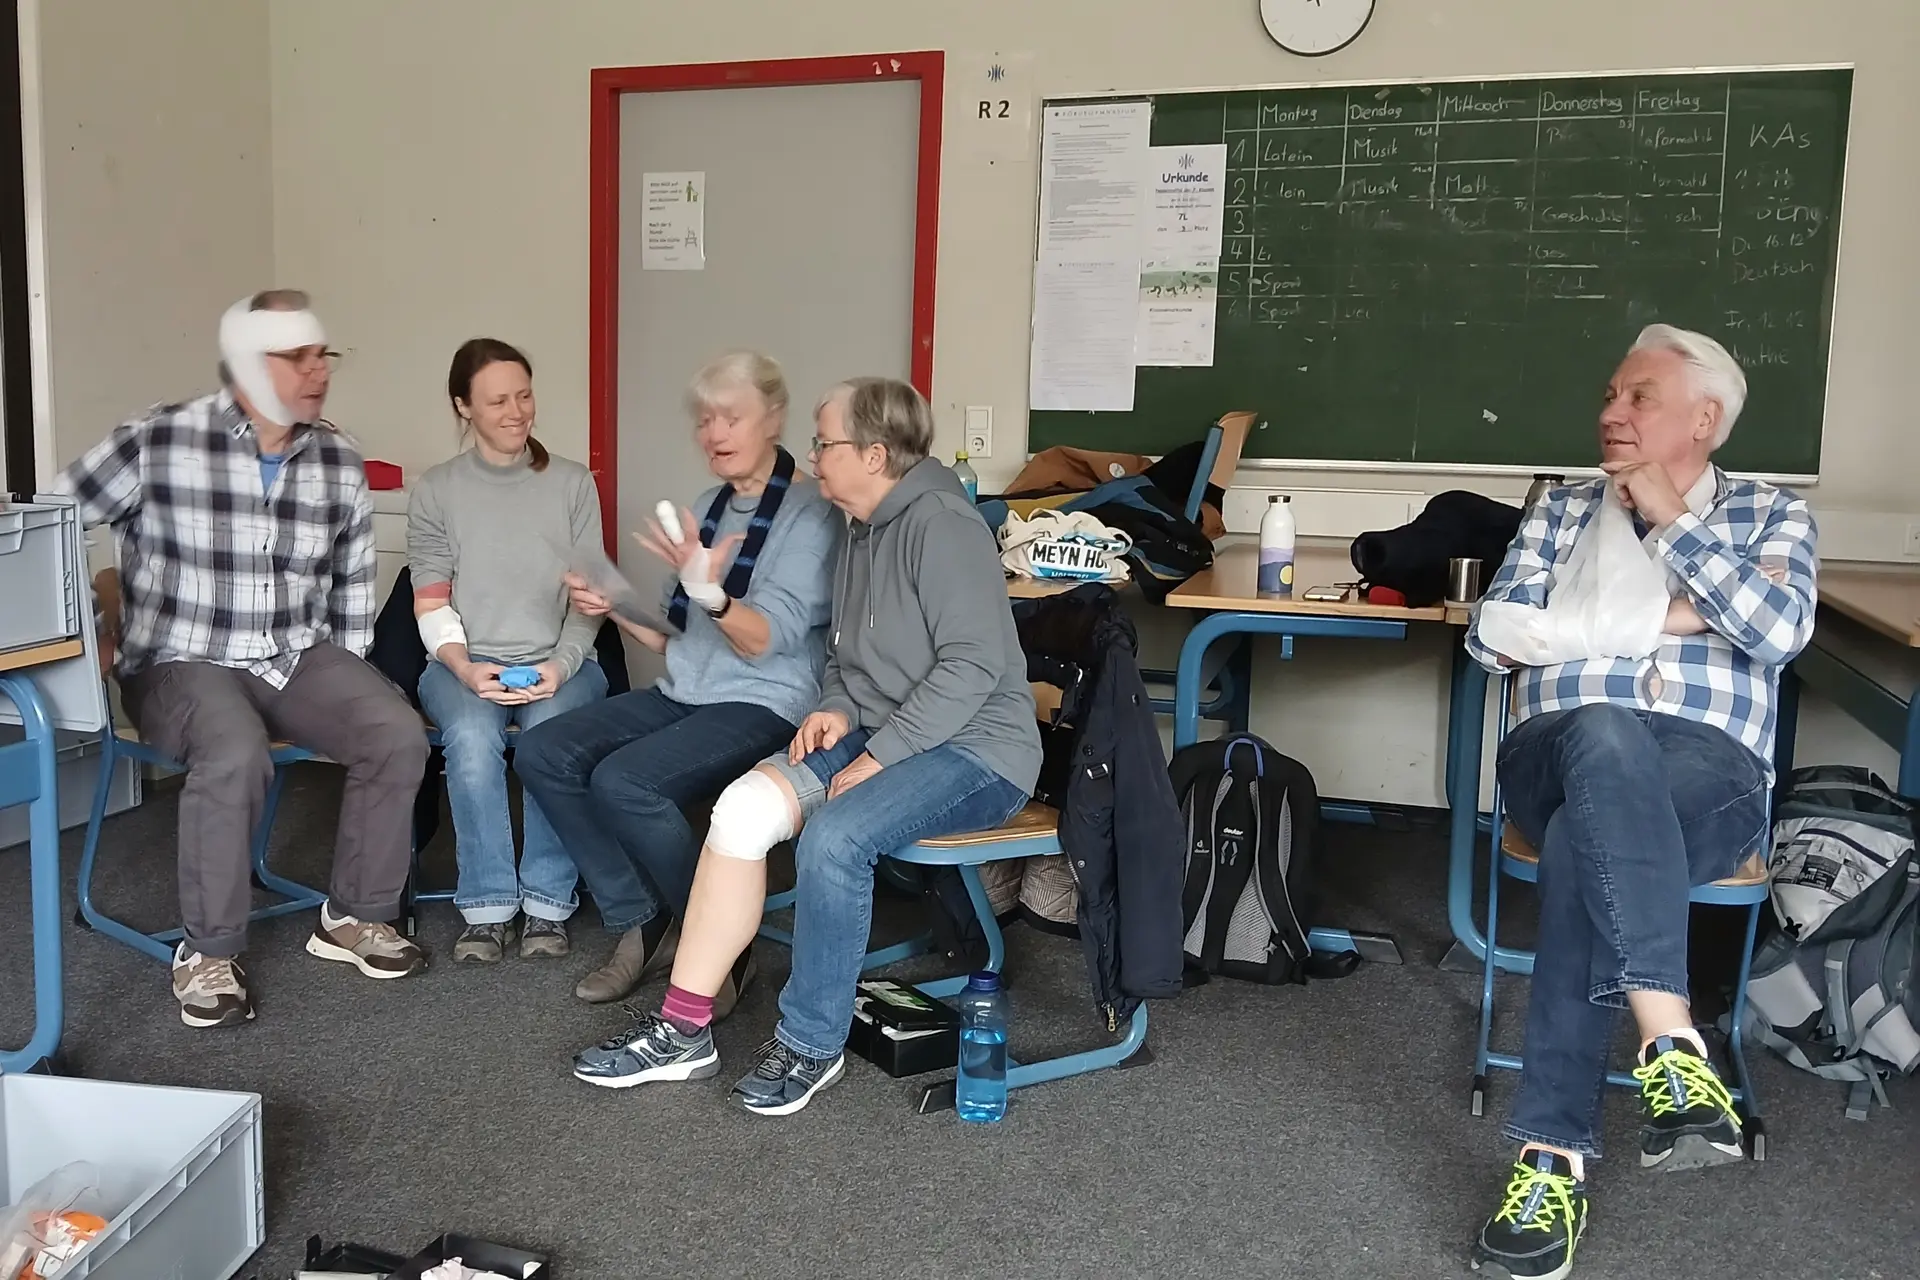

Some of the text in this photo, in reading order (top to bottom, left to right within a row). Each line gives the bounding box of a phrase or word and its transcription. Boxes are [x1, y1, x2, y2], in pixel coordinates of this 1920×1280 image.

[979, 100, 1010, 118] R 2
[1262, 103, 1318, 125] Montag
[1349, 100, 1403, 120] Dienstag
[1542, 90, 1623, 112] Donnerstag
[1638, 88, 1701, 111] Freitag
[1231, 138, 1246, 162] 1
[1263, 139, 1313, 162] Latein
[1352, 136, 1398, 160] Musik
[1162, 171, 1209, 184] Urkunde
[1232, 177, 1247, 204] 2
[1351, 175, 1399, 198] Musik
[1233, 210, 1245, 234] 3
[1230, 240, 1243, 260] 4
[1227, 271, 1241, 294] 5
[1032, 542, 1081, 567] MEYN
